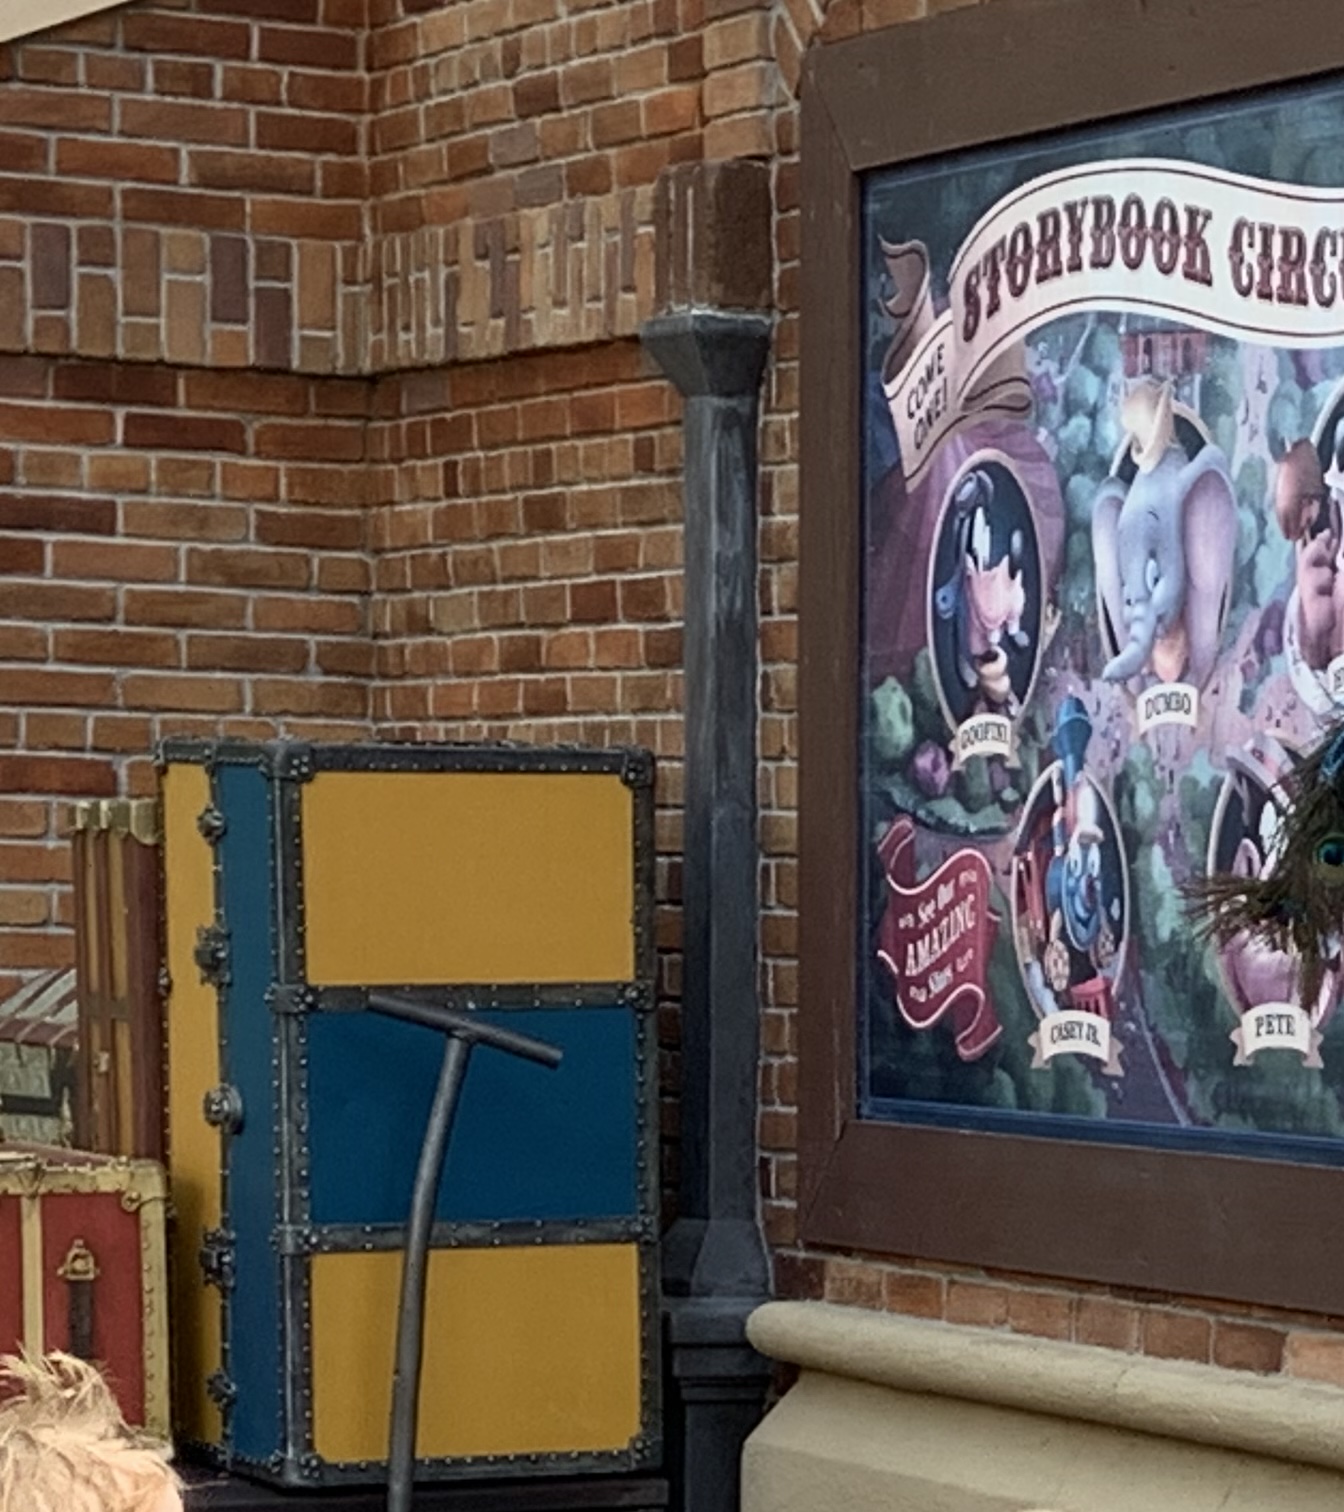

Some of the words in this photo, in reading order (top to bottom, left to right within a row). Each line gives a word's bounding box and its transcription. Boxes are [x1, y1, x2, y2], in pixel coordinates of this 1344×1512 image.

[962, 192, 1213, 343] STORYBOOK
[905, 893, 976, 976] AMAZING
[1254, 1014, 1296, 1038] PETE
